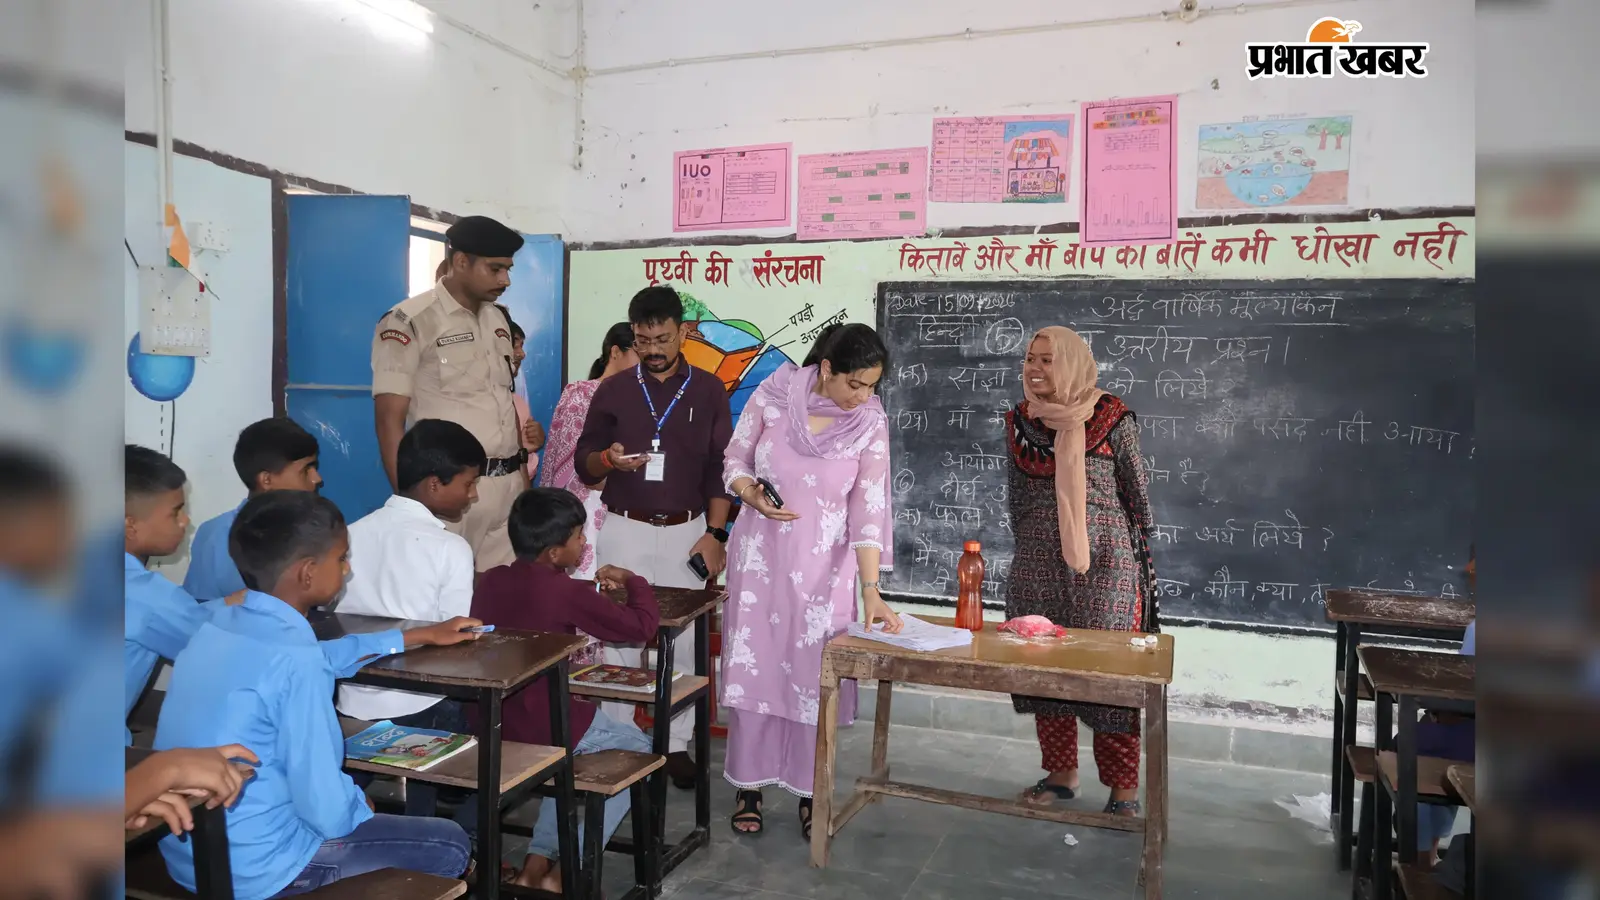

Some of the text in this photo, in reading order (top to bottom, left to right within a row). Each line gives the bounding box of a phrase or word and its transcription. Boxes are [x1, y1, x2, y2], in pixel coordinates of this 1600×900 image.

[643, 250, 826, 288] पृथ्वी की संरचना
[899, 242, 971, 275] किताबें
[974, 237, 1021, 273] और
[1024, 238, 1059, 270] माँ
[1211, 228, 1278, 266] कभी
[1291, 226, 1380, 267] धोखा
